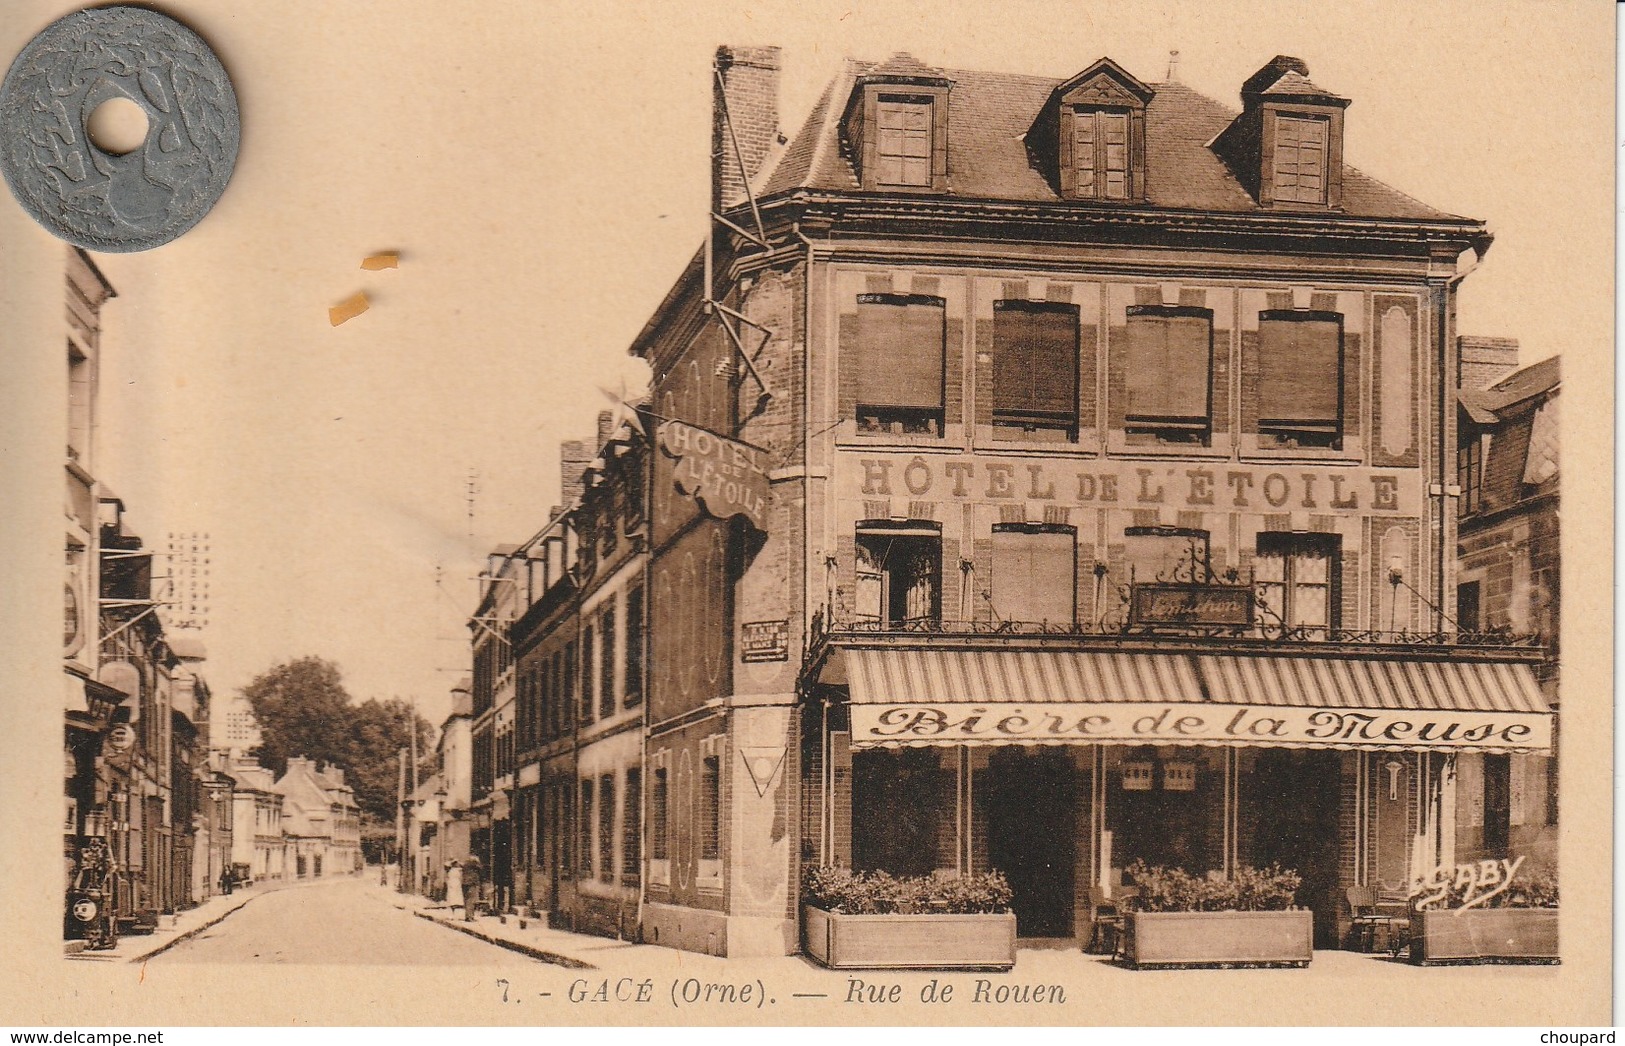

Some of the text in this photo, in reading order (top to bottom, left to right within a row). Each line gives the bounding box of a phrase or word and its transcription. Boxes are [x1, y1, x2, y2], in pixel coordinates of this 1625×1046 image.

[673, 424, 764, 474] HOTEL
[722, 464, 742, 478] DE
[860, 455, 1056, 500] HÔTEL
[1076, 473, 1118, 501] DE
[869, 707, 1533, 744] Bière de la Meuse
